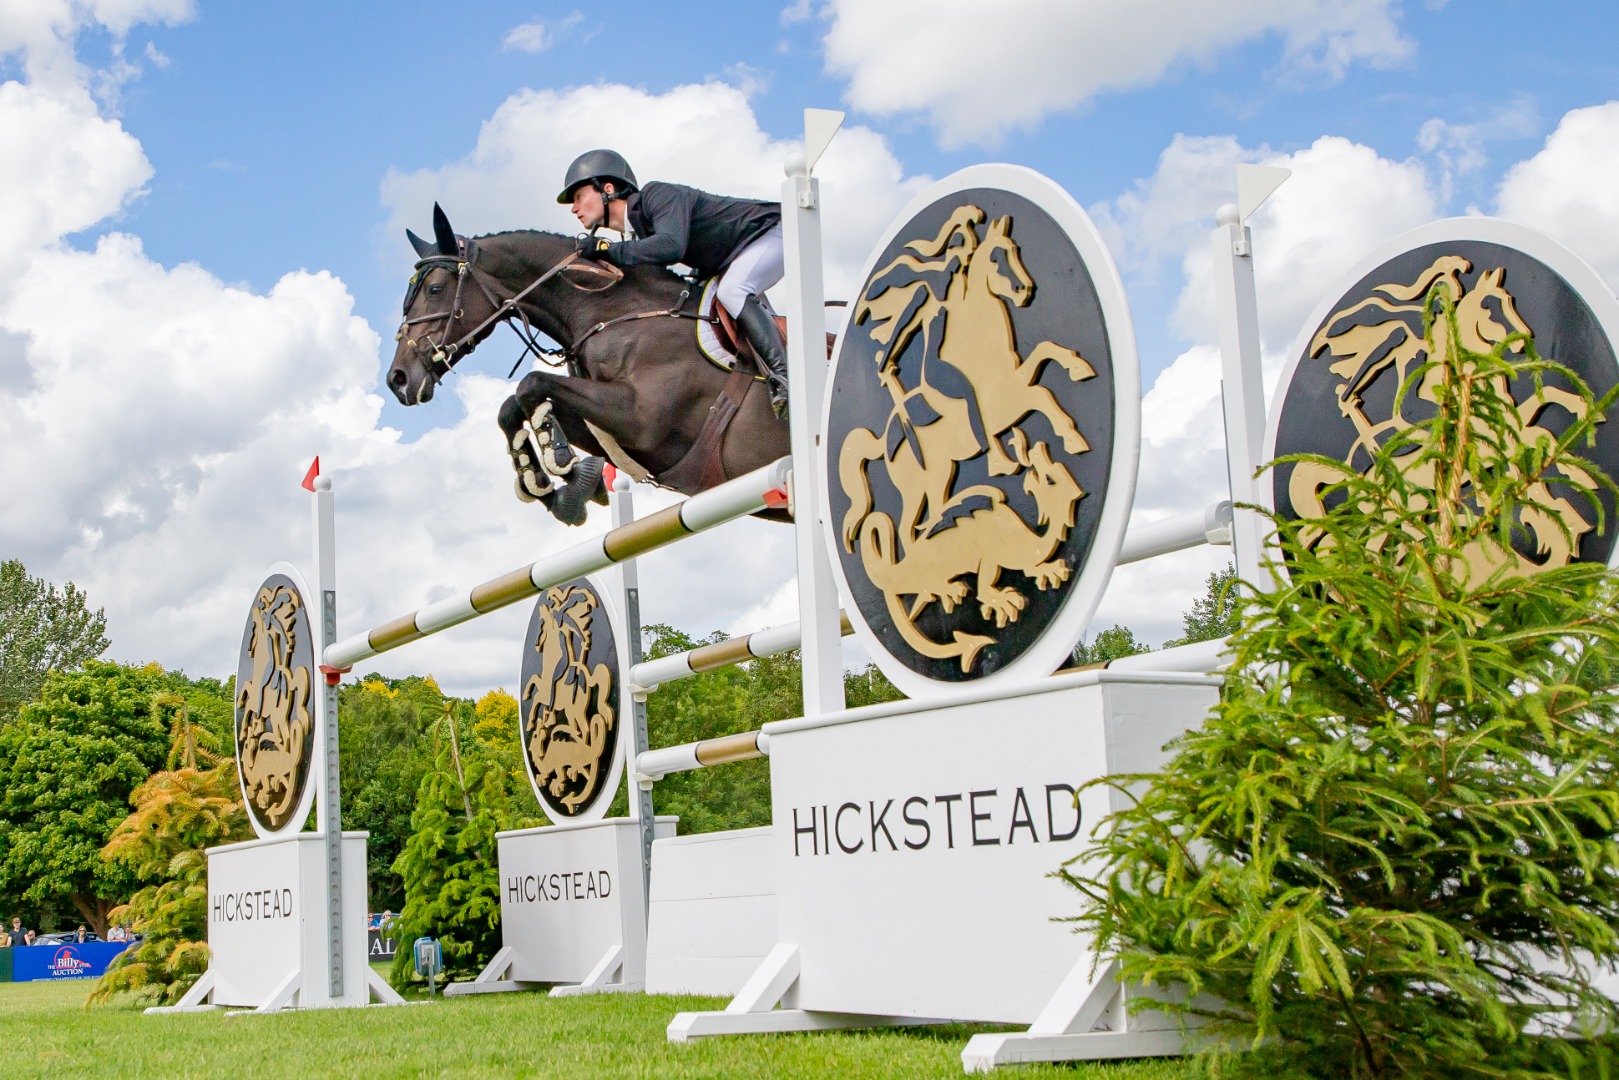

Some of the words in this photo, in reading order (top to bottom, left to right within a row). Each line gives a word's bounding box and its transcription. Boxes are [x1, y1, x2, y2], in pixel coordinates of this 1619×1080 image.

[792, 783, 1081, 856] HICKSTEAD
[508, 870, 611, 903] HICKSTEAD
[213, 888, 292, 922] HICKSTEAD
[52, 968, 83, 976] AUCTION
[57, 957, 79, 968] Billy
